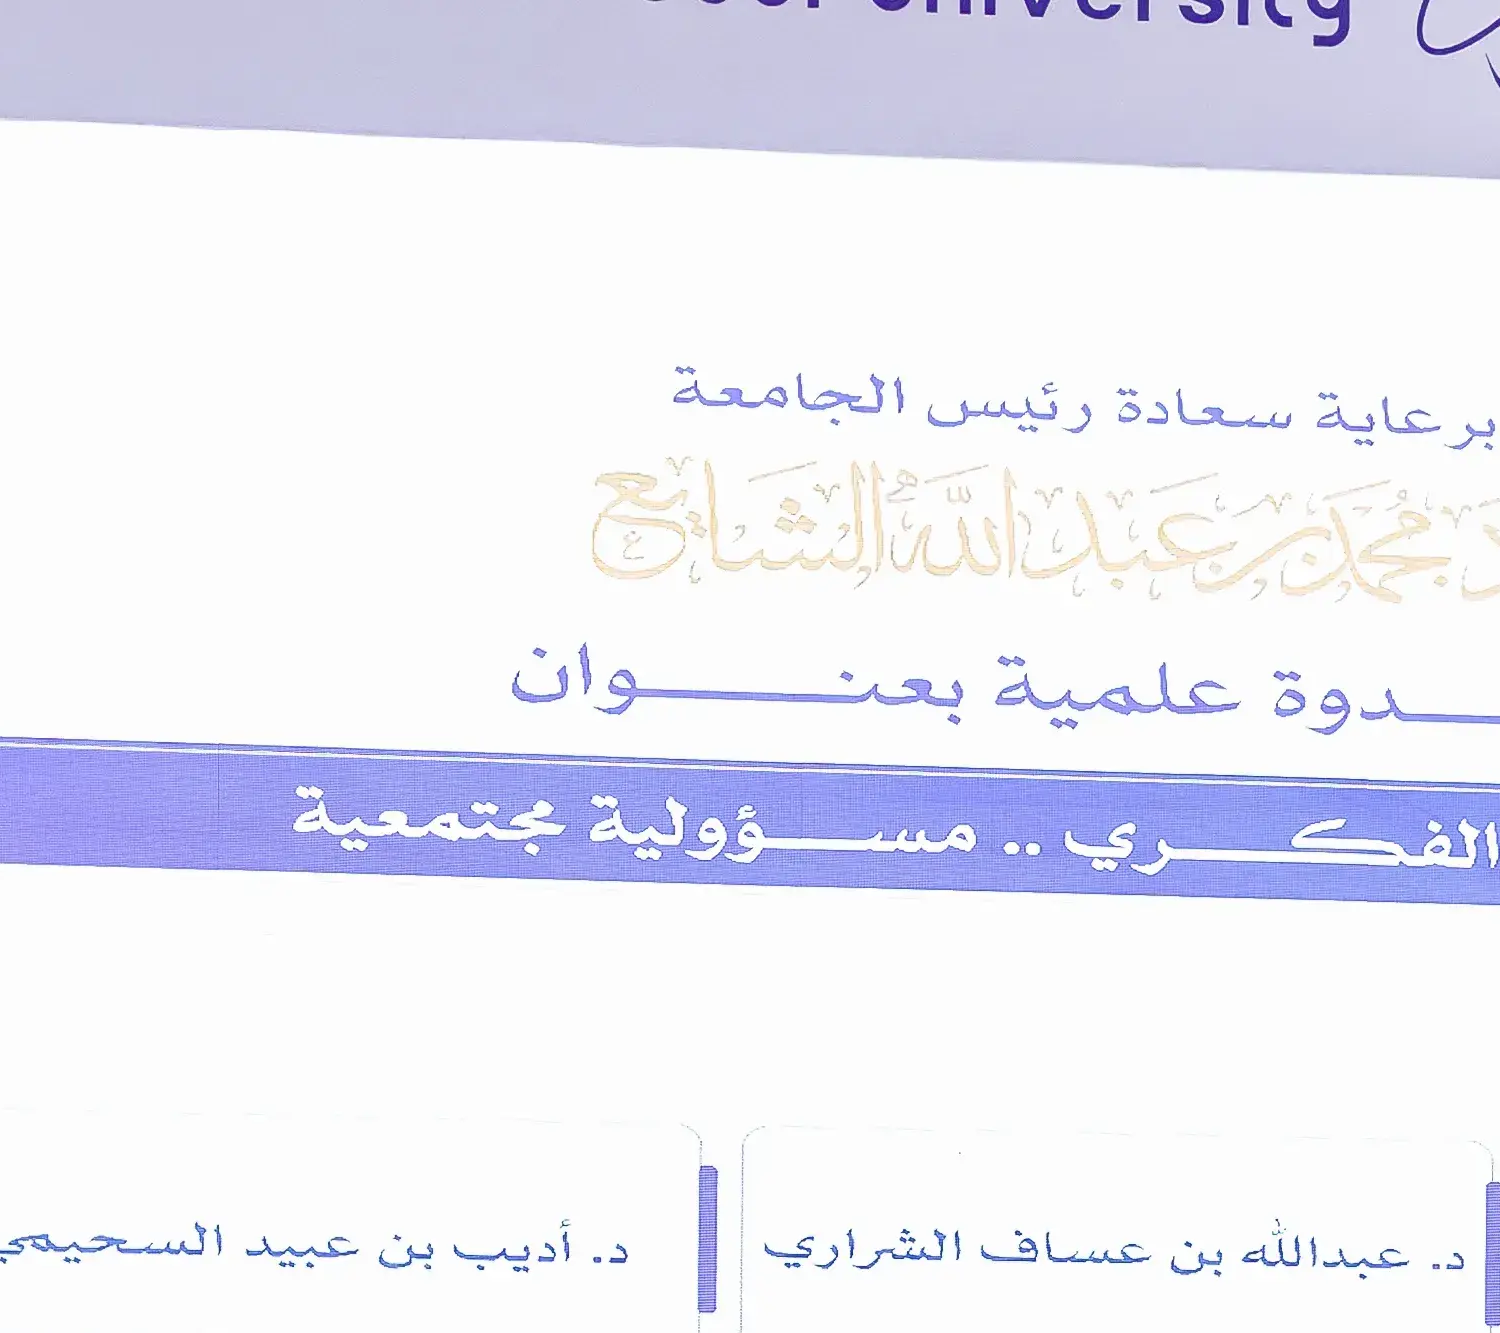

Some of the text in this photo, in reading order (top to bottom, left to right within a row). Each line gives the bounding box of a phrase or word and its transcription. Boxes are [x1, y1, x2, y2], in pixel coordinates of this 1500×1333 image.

[672, 365, 1497, 451] برعاية سعادة رئيس الجامعة
[511, 641, 965, 726] بعنوان
[994, 655, 1243, 731] علمية
[292, 785, 568, 856] مجتمعية
[589, 794, 978, 864] مسؤولية
[1063, 818, 1499, 876] الفكري
[244, 1235, 361, 1269] عبيد
[378, 1234, 435, 1270] بن
[452, 1218, 572, 1274] أديب
[763, 1228, 963, 1270] الشراري
[980, 1229, 1153, 1264] عساف
[1170, 1240, 1224, 1278] بن
